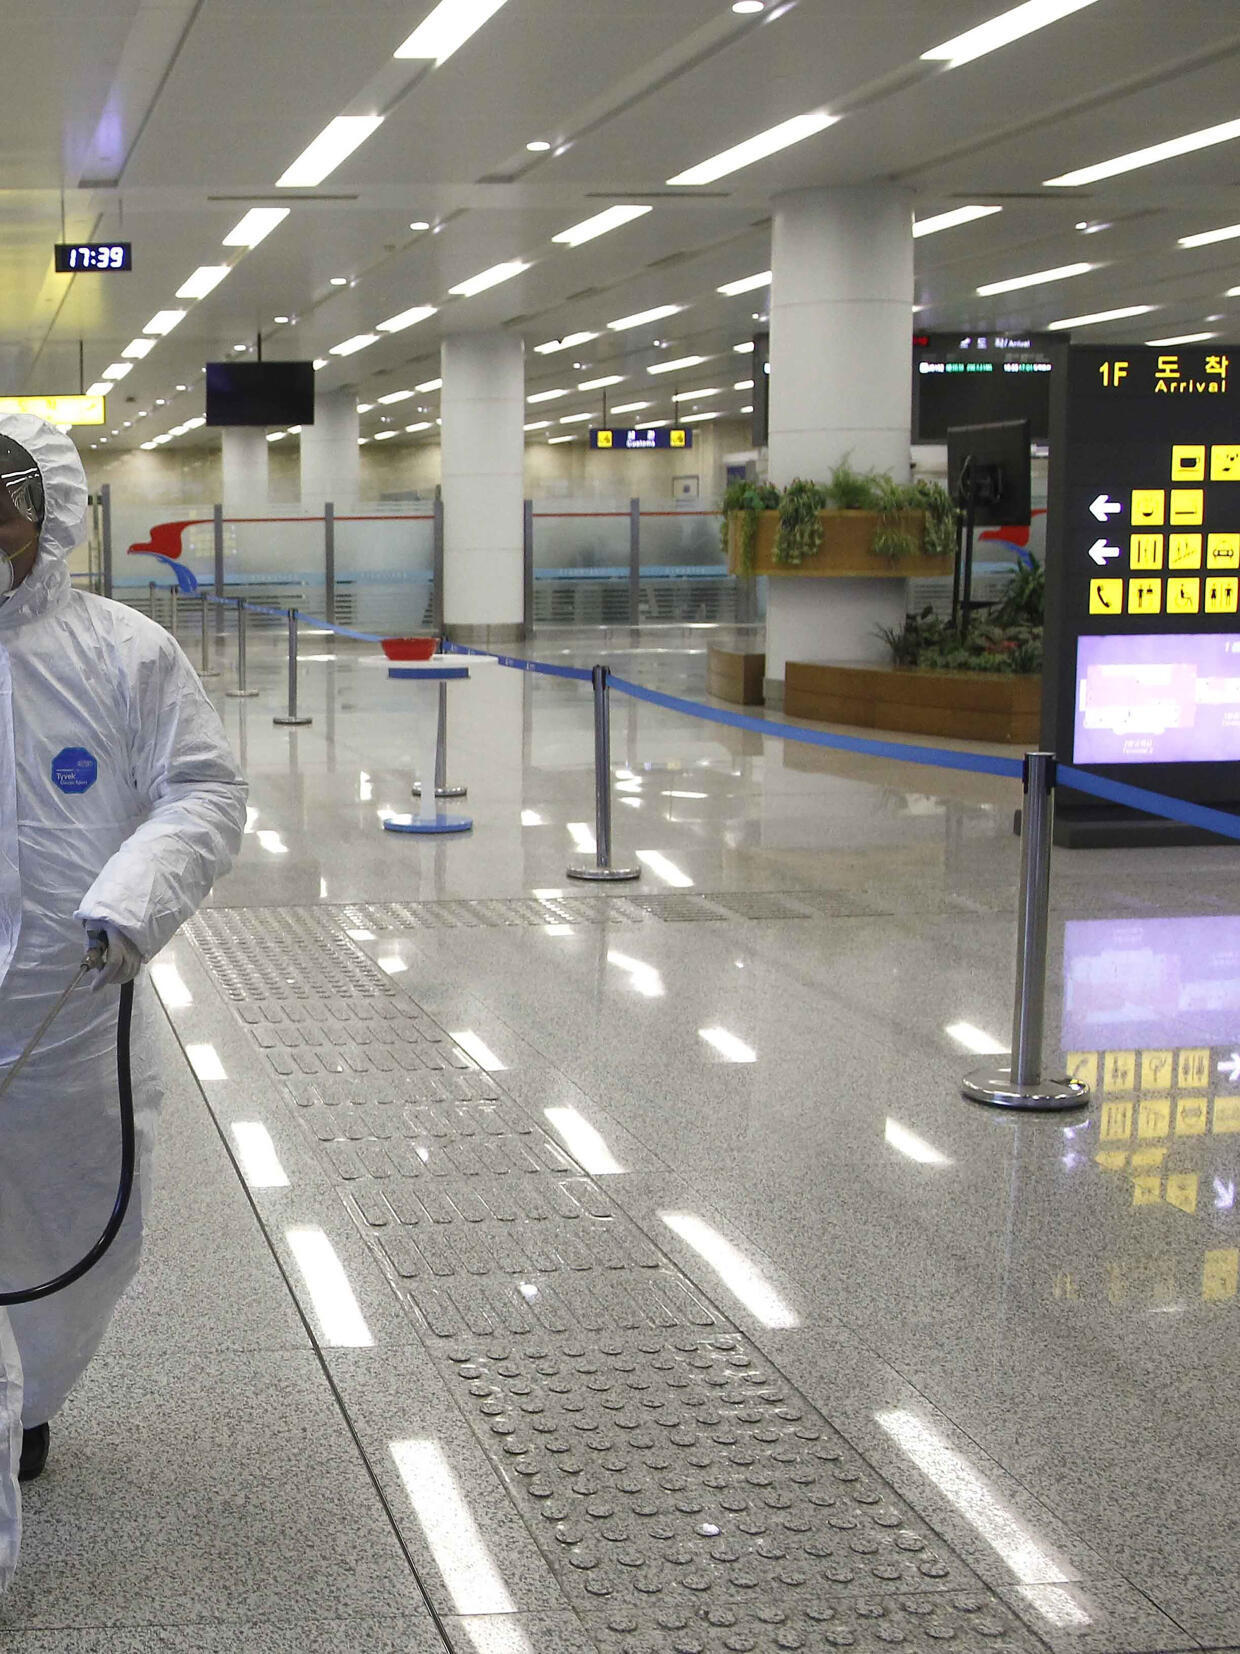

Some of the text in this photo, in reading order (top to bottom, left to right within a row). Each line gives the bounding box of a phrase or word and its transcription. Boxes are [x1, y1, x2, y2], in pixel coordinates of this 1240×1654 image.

[69, 247, 124, 268] 17:39
[1099, 361, 1129, 387] 1F
[1154, 379, 1227, 393] Arrival
